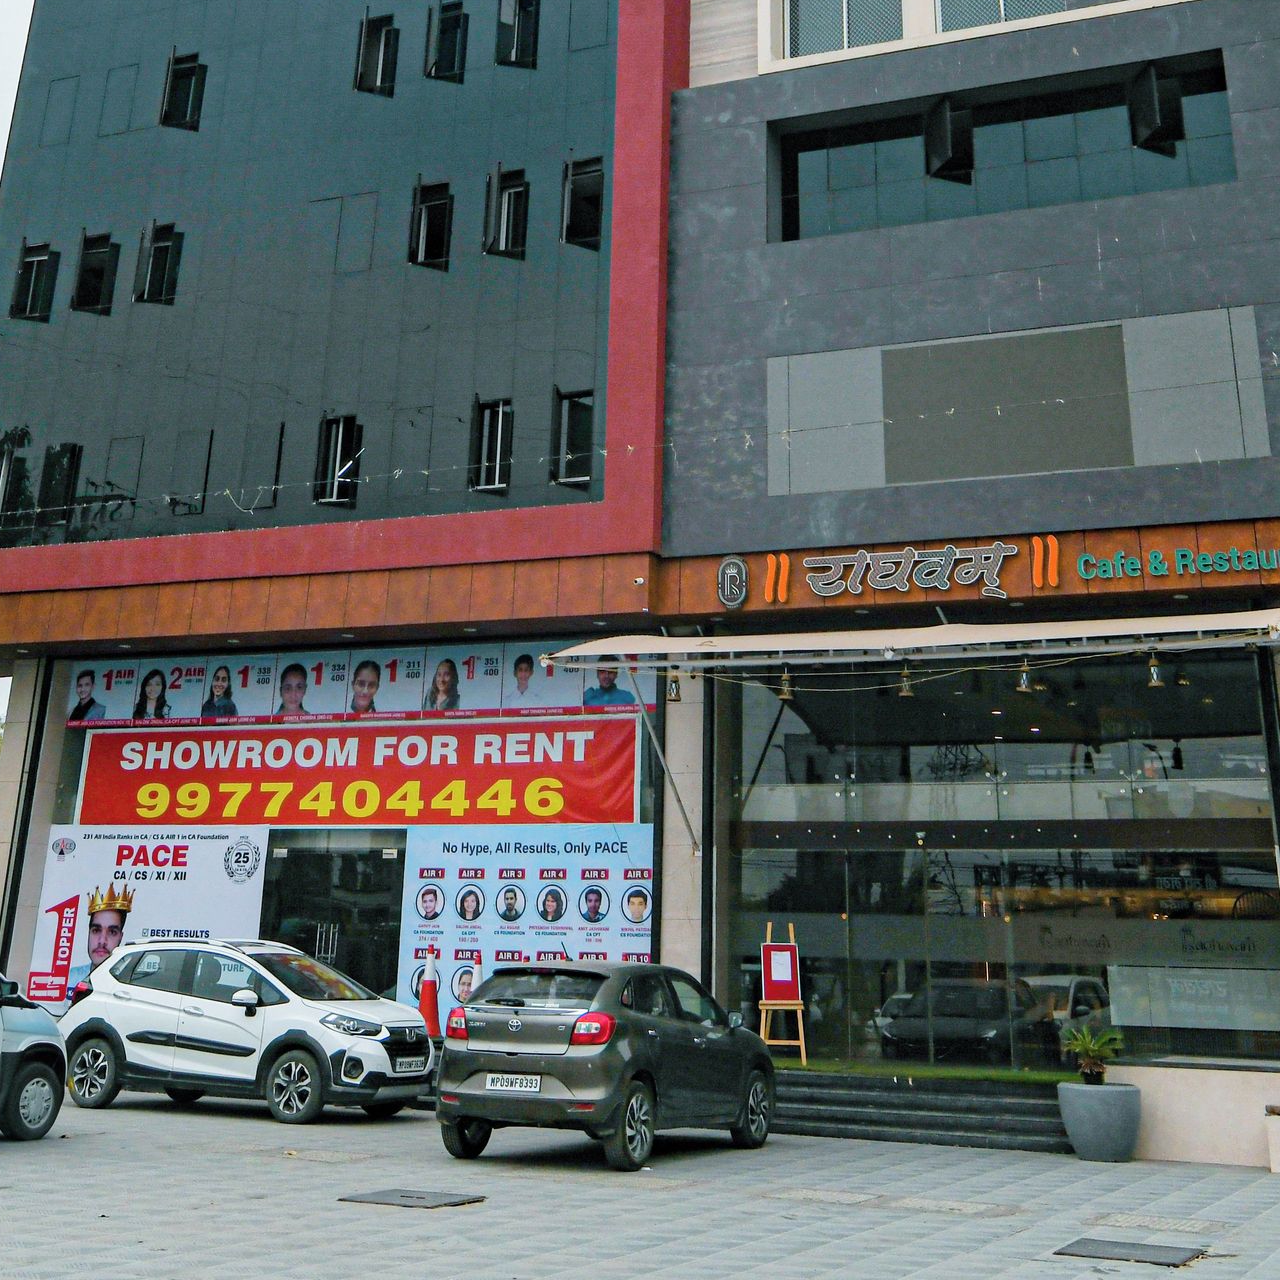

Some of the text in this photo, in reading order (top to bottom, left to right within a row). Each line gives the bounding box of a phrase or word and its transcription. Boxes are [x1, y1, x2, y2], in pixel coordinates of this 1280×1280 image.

[1077, 550, 1141, 580] Cafe
[1148, 550, 1168, 576] &
[115, 669, 135, 679] AIR
[406, 671, 420, 679] 400
[484, 668, 499, 676] 400
[168, 666, 205, 690] 2 AIR
[120, 731, 595, 771] SHOWROOM FOR RENT
[135, 777, 565, 818] 9977404446
[442, 841, 628, 857] No Hype, All Results, Only PACE
[115, 844, 189, 867] PACE
[234, 852, 250, 864] 25
[113, 871, 127, 880] CA
[134, 871, 148, 880] CS
[155, 871, 165, 880] XI
[173, 871, 187, 881] XII
[422, 870, 442, 878] AIR 1
[461, 870, 482, 878] AIR 2
[501, 870, 522, 878] AIR 3
[542, 870, 564, 878] AIR 4
[626, 870, 649, 878] AIR 6
[150, 929, 210, 939] BEST RESULTS
[458, 951, 471, 959] AIR
[490, 1075, 538, 1089] MP09WF8393
